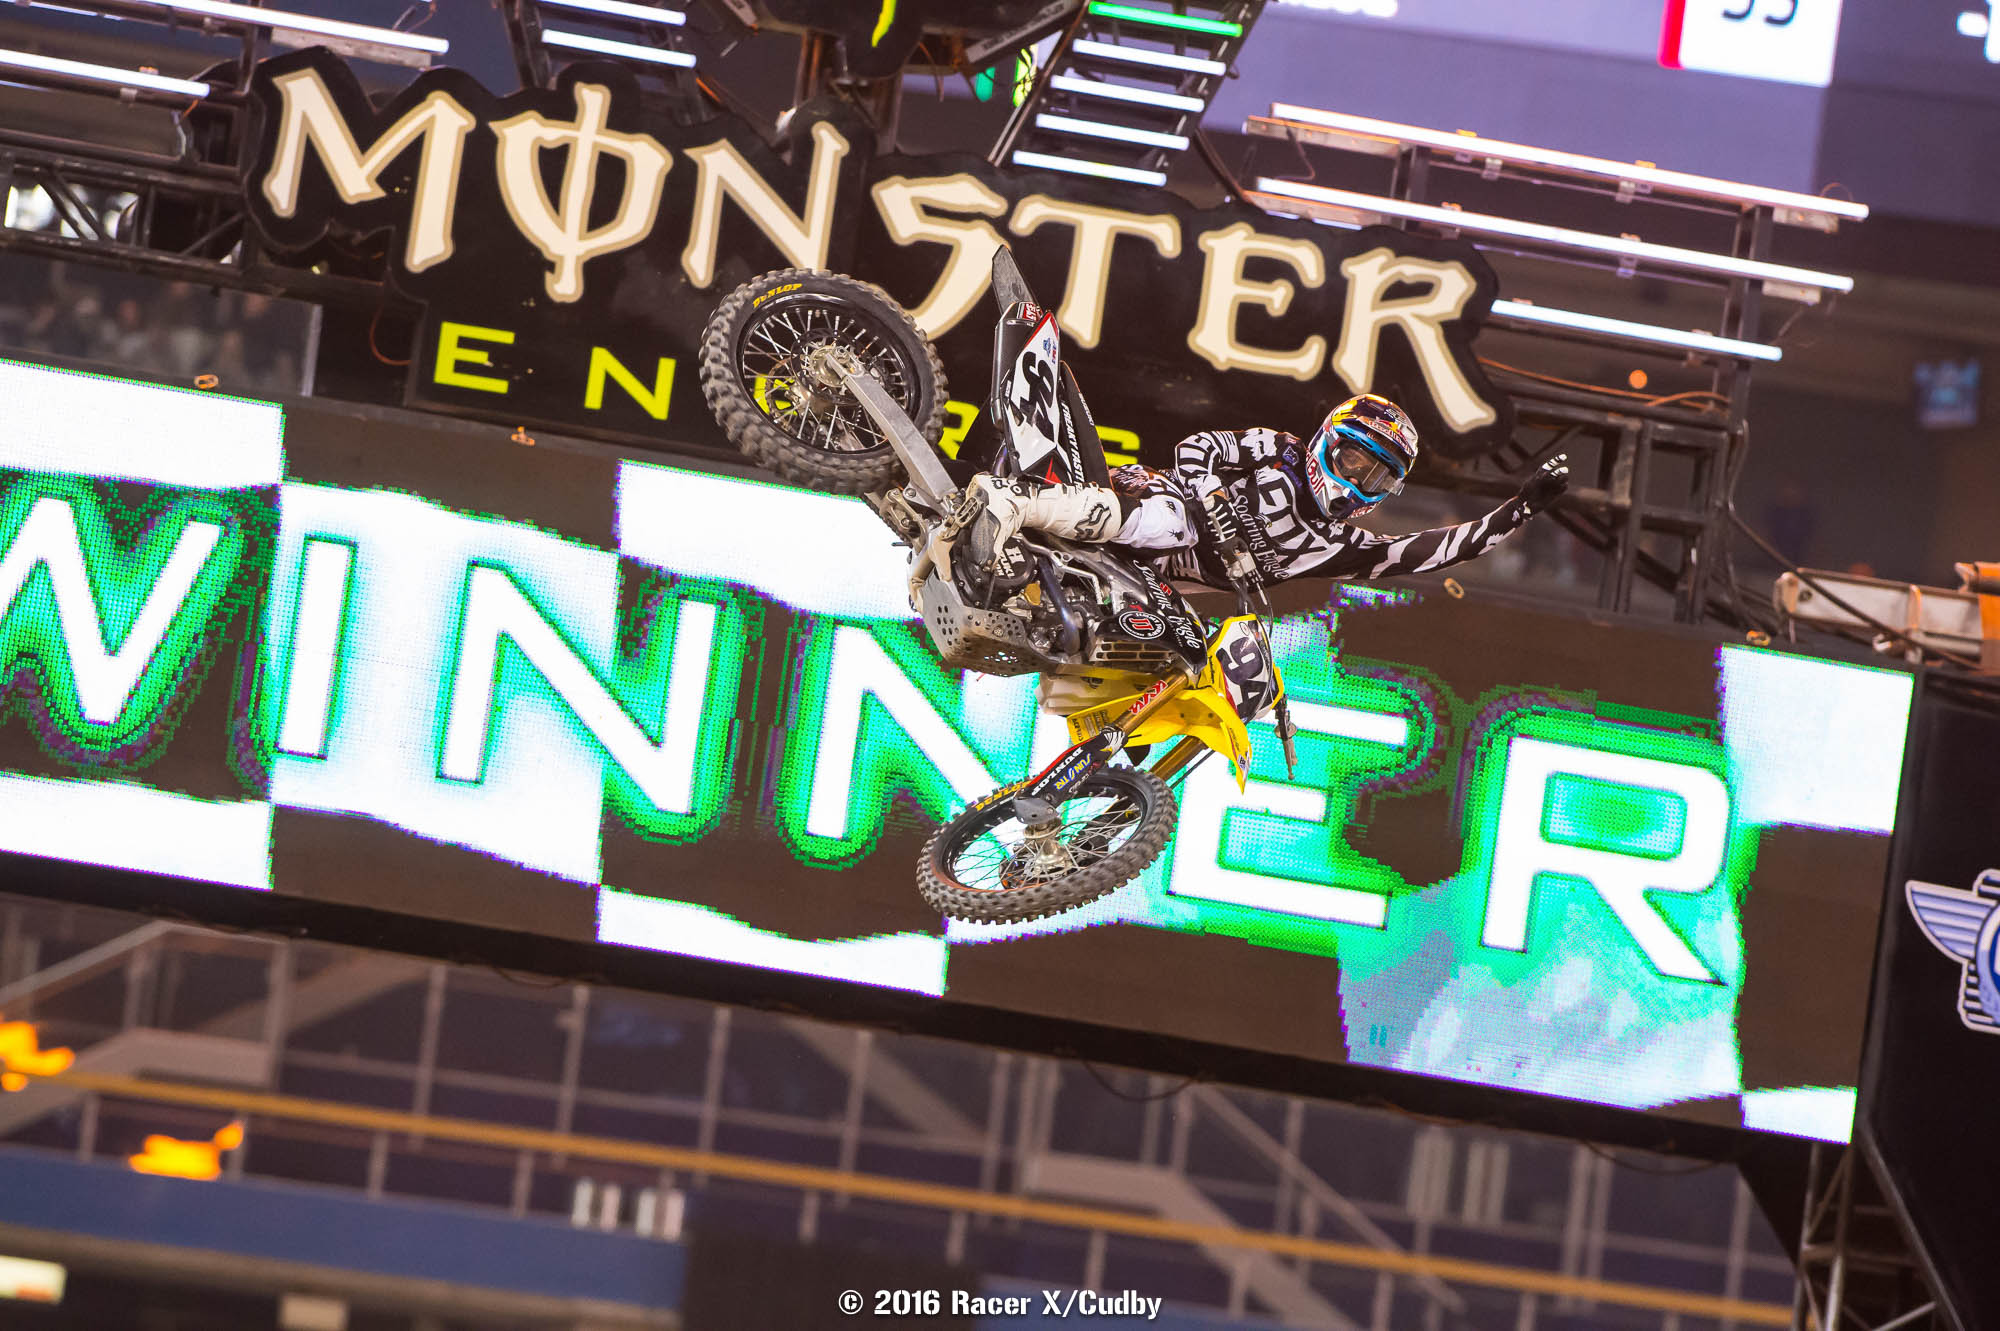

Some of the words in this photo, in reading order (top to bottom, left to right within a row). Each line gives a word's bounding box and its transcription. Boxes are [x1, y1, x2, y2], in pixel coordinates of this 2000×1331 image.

[262, 67, 1497, 434] MONSTER
[752, 283, 803, 308] DUNLOP
[1061, 402, 1079, 448] FREAKY
[1232, 494, 1266, 551] Soaring
[1258, 544, 1291, 580] Eagle
[1215, 636, 1269, 723] 94
[0, 496, 1729, 985] WINNER
[1031, 748, 1084, 796] DUNLOP
